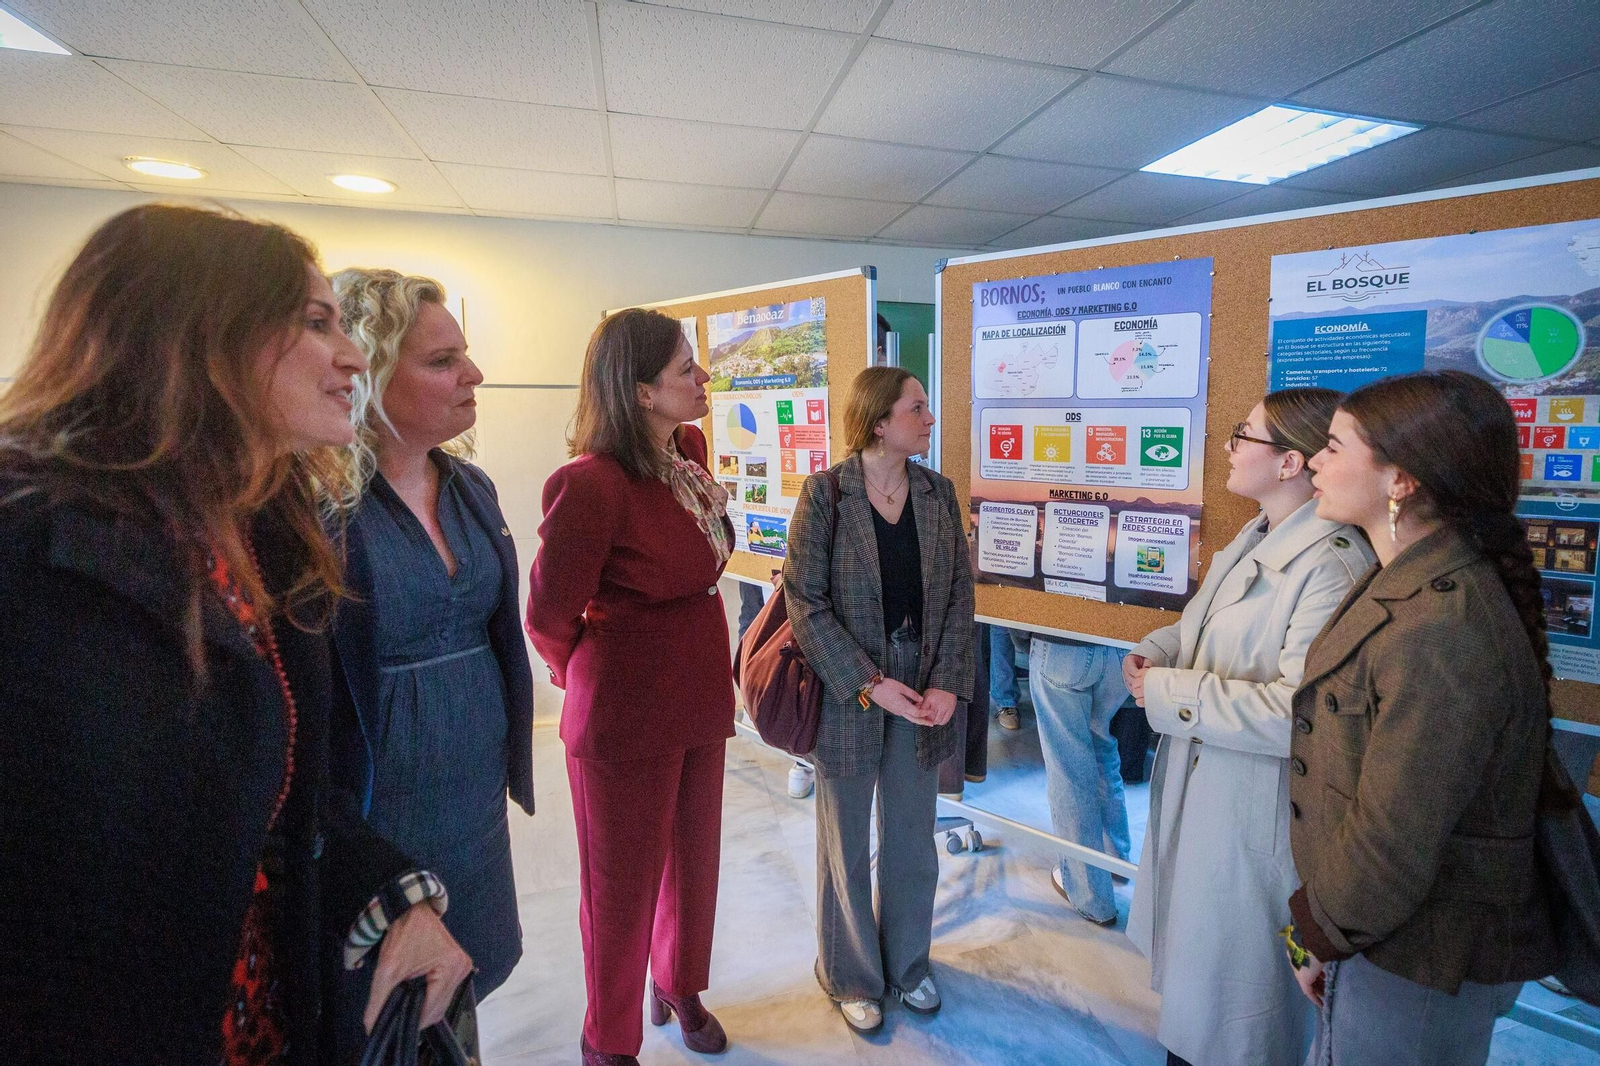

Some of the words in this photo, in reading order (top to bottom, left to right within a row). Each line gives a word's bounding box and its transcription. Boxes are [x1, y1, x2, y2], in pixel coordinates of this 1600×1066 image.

[1068, 284, 1091, 294] PUEBLO
[1093, 281, 1120, 292] BLANCO
[1122, 280, 1136, 289] CON
[1139, 276, 1172, 288] ENCANTO
[1306, 281, 1326, 292] EL
[1332, 273, 1410, 290] BOSQUE
[981, 283, 1046, 307] BORNOS;
[1055, 307, 1070, 316] ODS
[1078, 302, 1121, 314] MARKETING
[1124, 302, 1137, 311] 6.0
[737, 310, 784, 325] Benaocaz
[1114, 317, 1158, 330] ECONOMÍA
[1314, 322, 1369, 334] ECONOMÍA
[982, 330, 1000, 339] MAPA
[1001, 329, 1010, 338] DE
[1012, 324, 1066, 337] LOCALIZACIÓN
[1065, 412, 1081, 421] ODS
[992, 427, 996, 435] 5
[1034, 428, 1039, 436] 7
[1088, 427, 1093, 436] 9
[1142, 429, 1151, 438] 13
[1049, 489, 1092, 500] MARKETING
[982, 506, 1015, 514] SEGMENTOS
[1054, 508, 1104, 519] ACTUACIONES
[1058, 517, 1099, 527] CONCRETAS
[1124, 515, 1170, 526] ESTRATEGIA
[1147, 526, 1184, 536] SOCIALES
